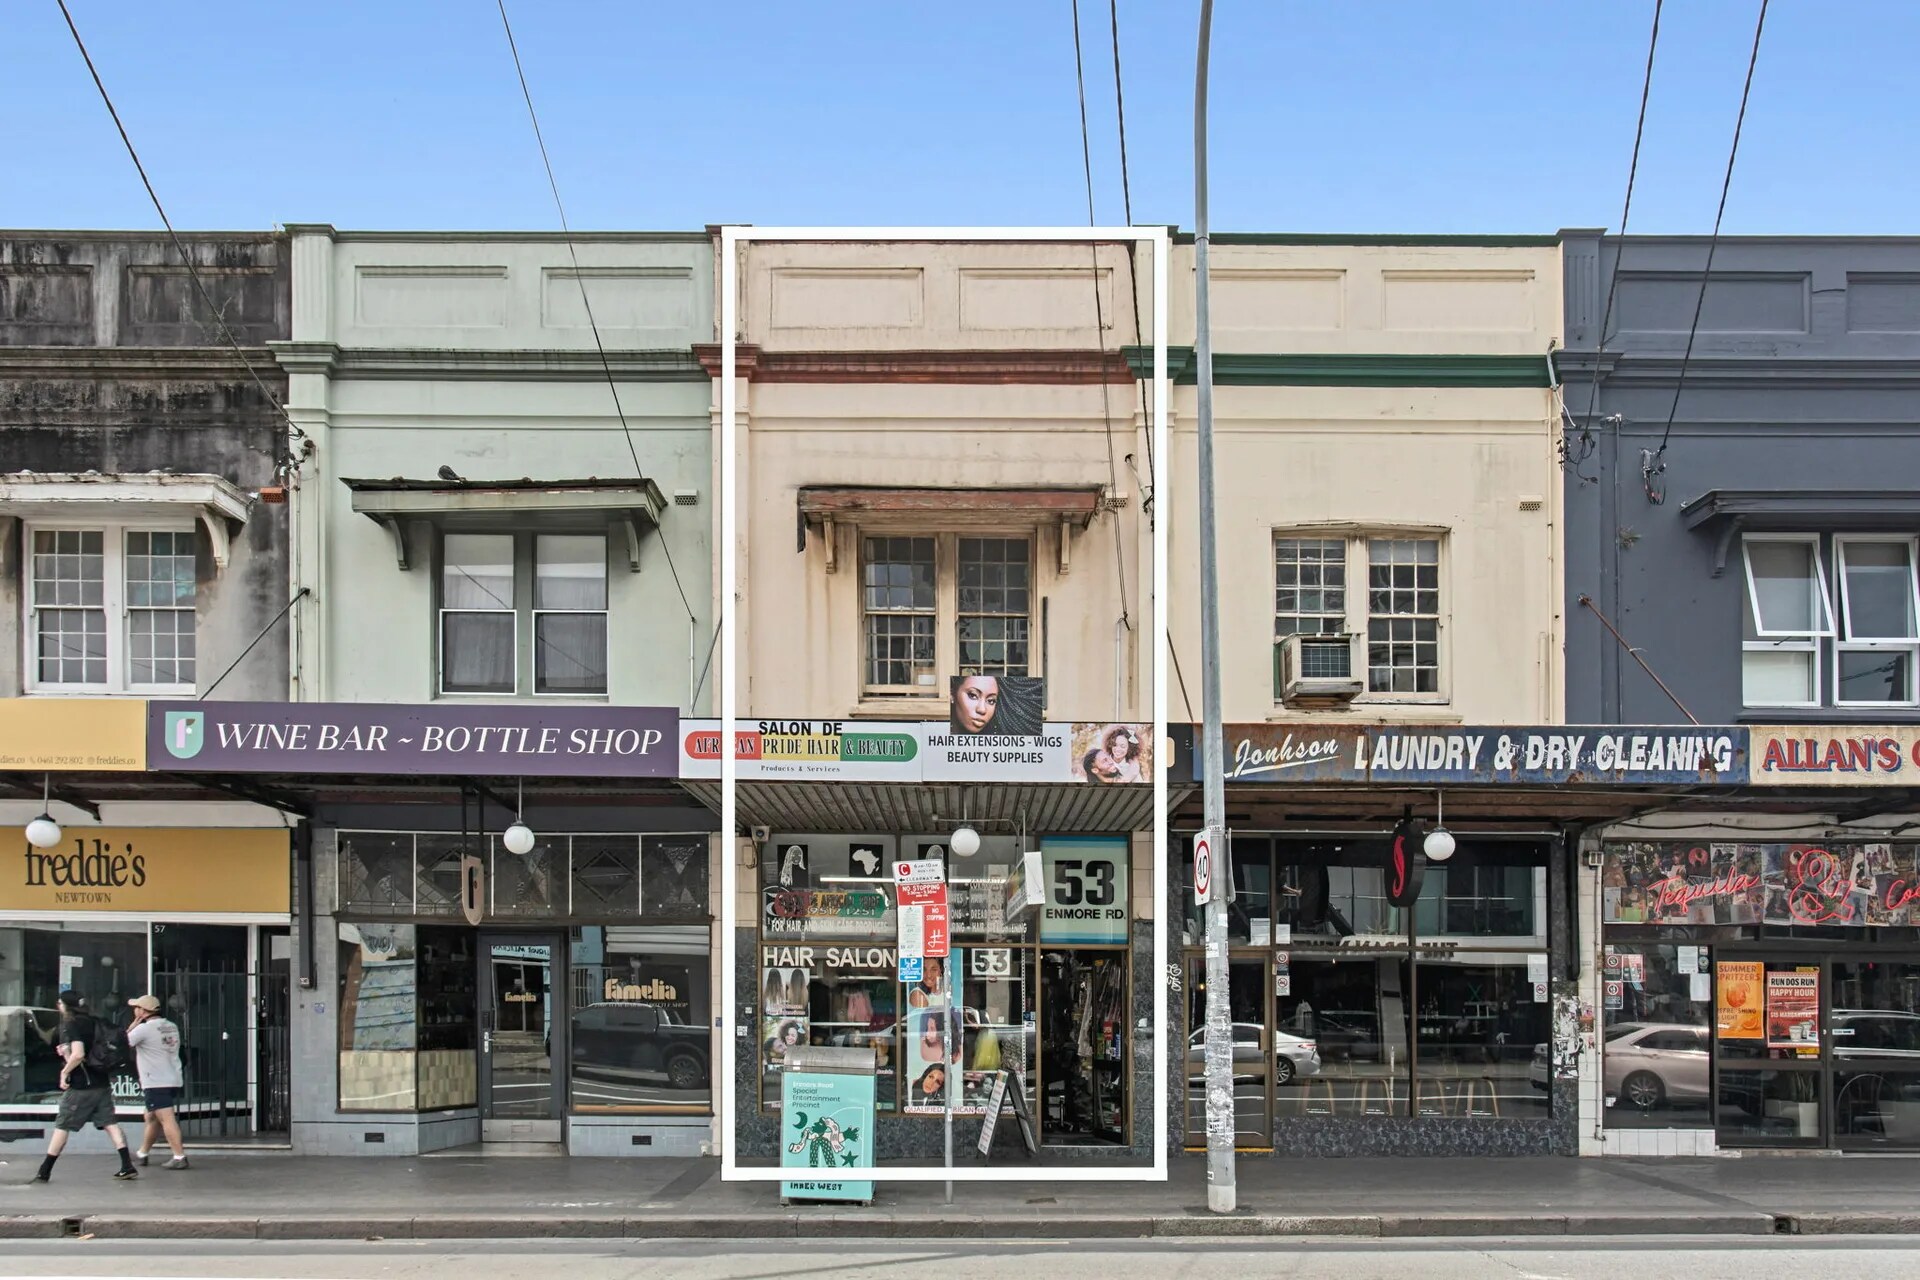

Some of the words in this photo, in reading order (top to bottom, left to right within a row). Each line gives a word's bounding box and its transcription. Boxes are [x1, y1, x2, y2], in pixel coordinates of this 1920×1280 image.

[758, 721, 812, 736] SALON
[822, 722, 843, 736] DE
[216, 723, 311, 750] WINE
[317, 725, 389, 751] BAR
[421, 726, 560, 754] BOTTLE
[566, 728, 663, 755] SHOP
[694, 737, 755, 754] AFRAN
[762, 738, 803, 754] PRIDE
[807, 738, 839, 755] HAIR
[845, 739, 853, 755] &
[858, 739, 907, 756] BEAUTY
[928, 735, 956, 747] HAIR
[957, 735, 1026, 748] EXTENSIONS
[1033, 736, 1062, 748] WIGS
[947, 751, 992, 763] BEAUTY
[992, 752, 1044, 763] SUPPLIES
[1354, 735, 1485, 770] LAUNDRY
[1494, 735, 1513, 770] &
[1525, 735, 1586, 770] DRY
[1595, 735, 1732, 771] CLEANING
[1762, 738, 1902, 772] ALLAN'S
[806, 765, 841, 773] Services
[25, 838, 146, 888] freddie's
[1197, 855, 1208, 879] 40
[1054, 860, 1115, 906] 53
[1646, 864, 1761, 916] Tequila
[1789, 849, 1855, 922] &
[55, 892, 112, 904] NEWTOWN
[1045, 908, 1101, 919] ENMORE
[1105, 909, 1126, 919] RD.
[771, 920, 784, 932] FOR
[787, 920, 801, 932] HAIR
[763, 946, 815, 967] HAIR
[825, 947, 897, 968] SALON
[974, 951, 1008, 972] 53
[1719, 965, 1757, 973] SUMMER
[605, 978, 677, 1000] famelia
[1770, 978, 1785, 986] RUN
[505, 992, 537, 1002] famelia
[1770, 988, 1792, 997] HAPPY
[1794, 989, 1815, 997] HOUR
[817, 1182, 843, 1191] WEST
